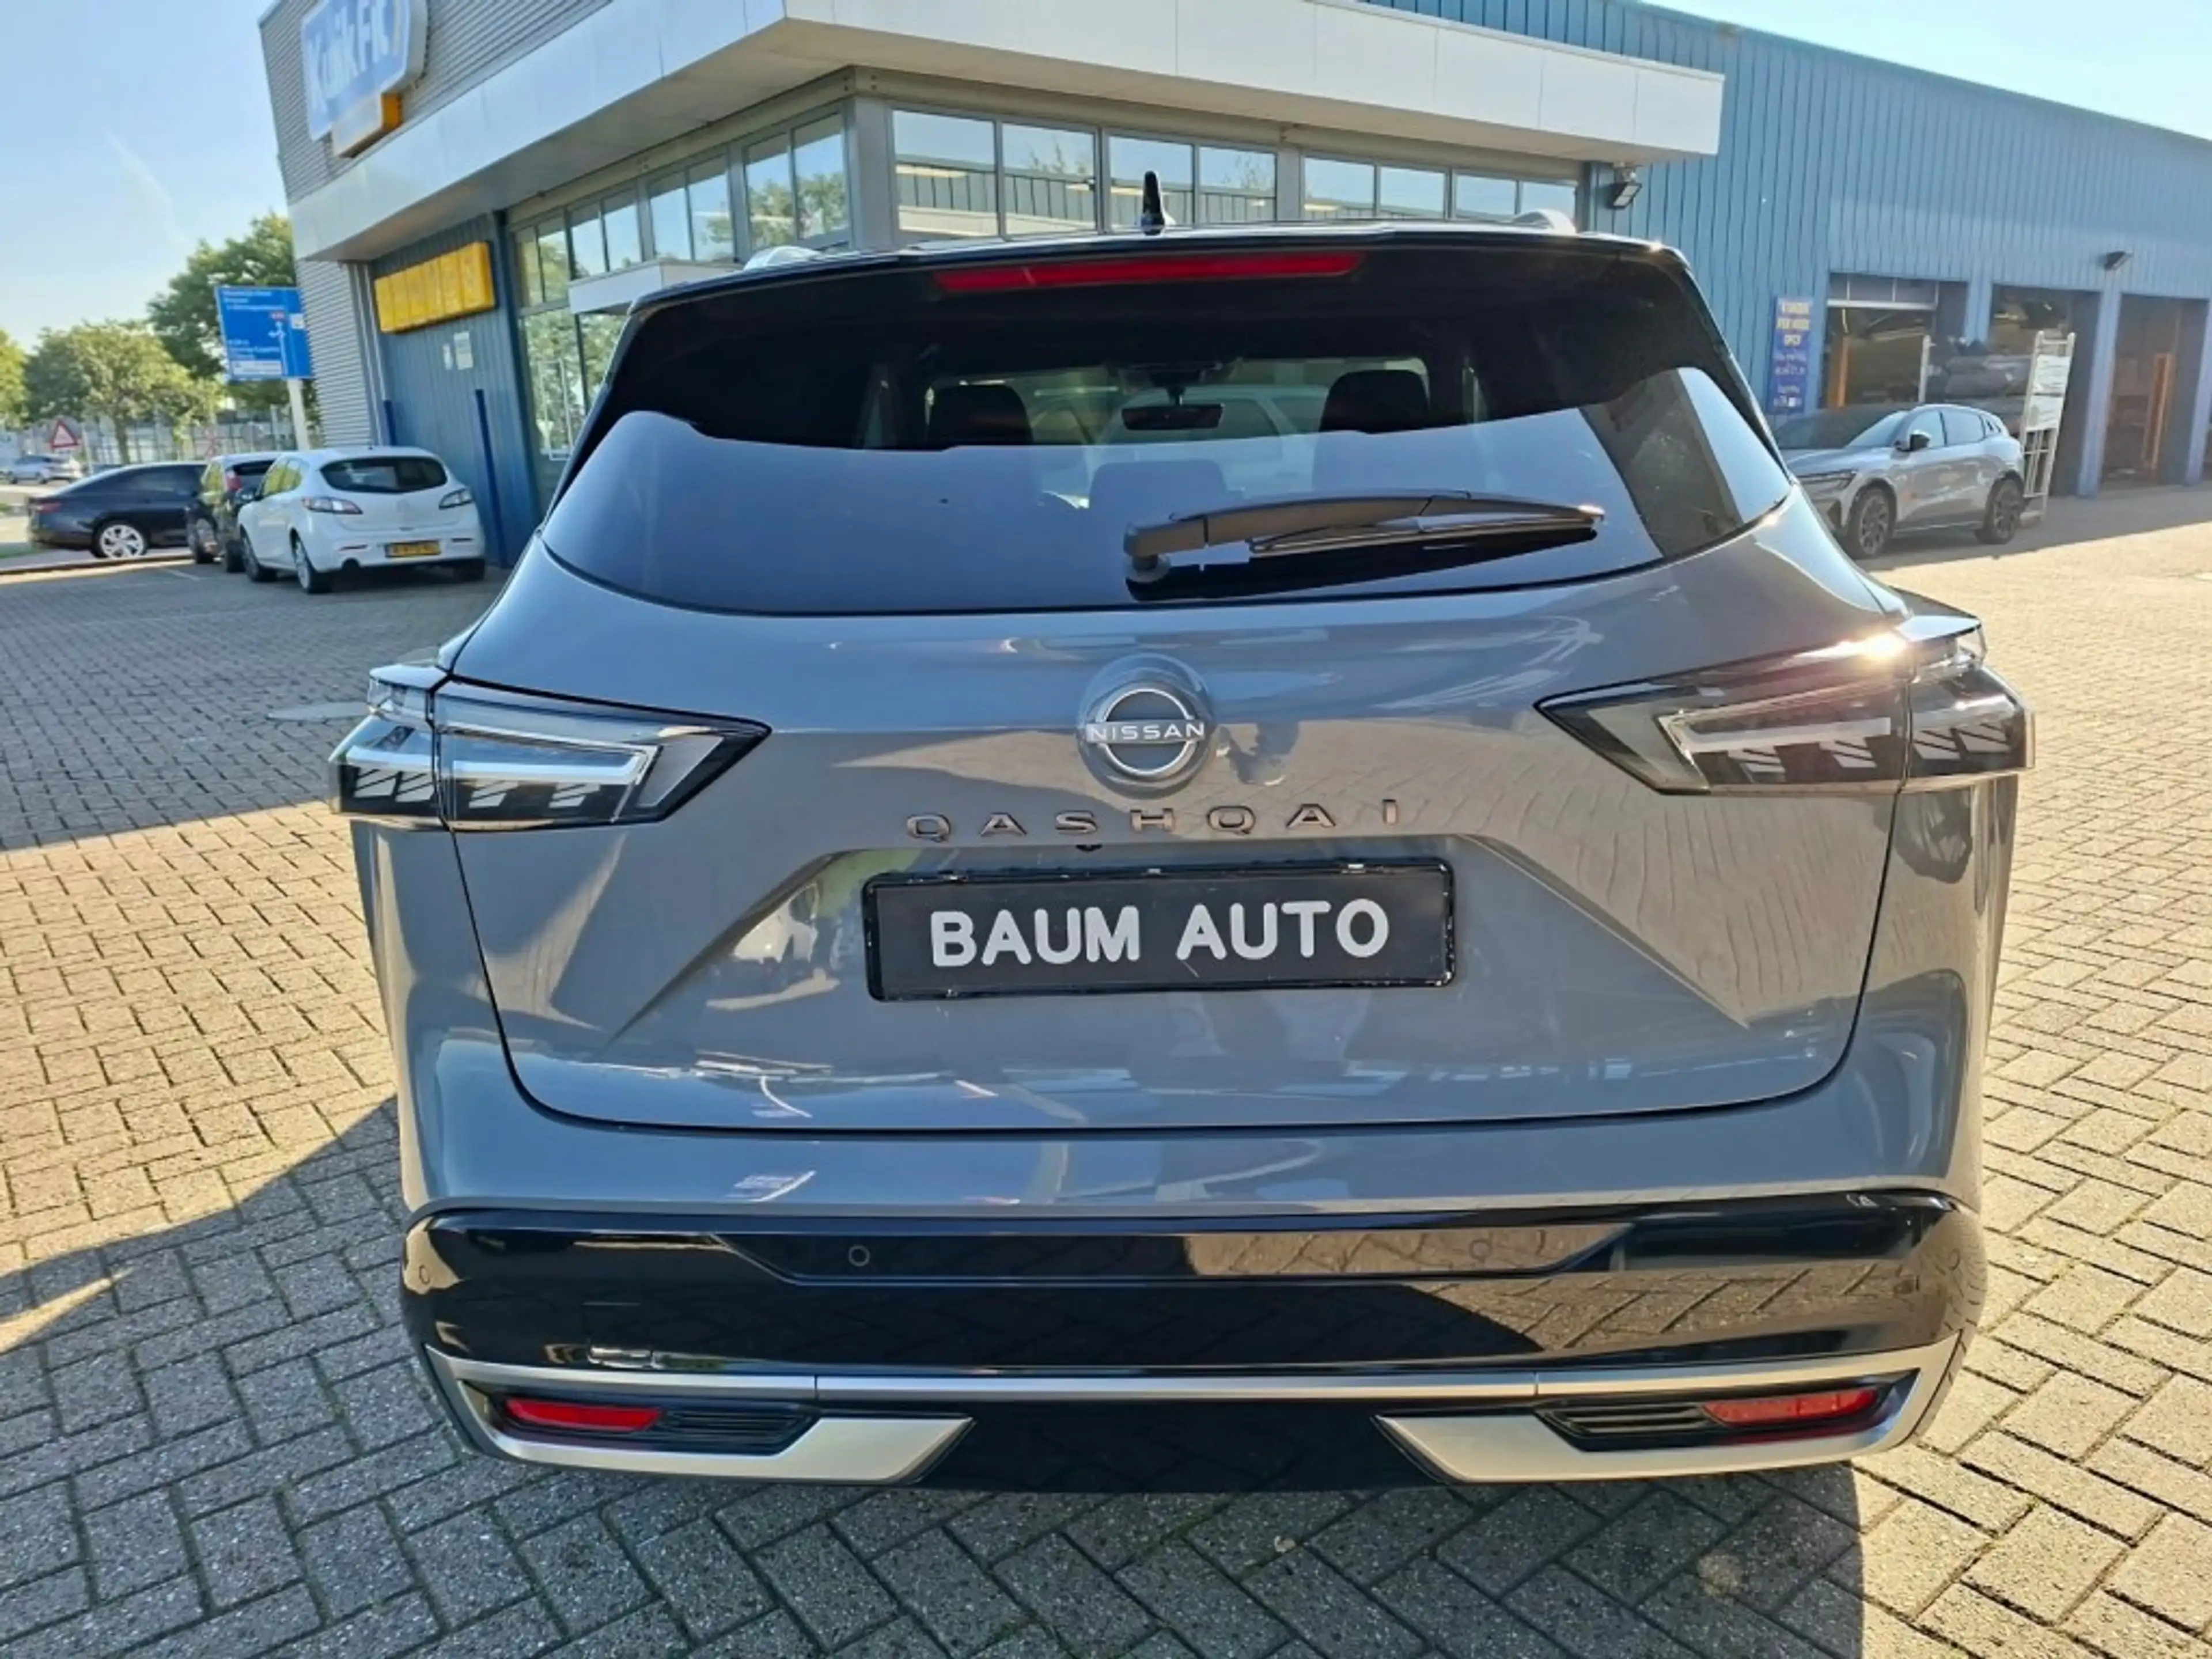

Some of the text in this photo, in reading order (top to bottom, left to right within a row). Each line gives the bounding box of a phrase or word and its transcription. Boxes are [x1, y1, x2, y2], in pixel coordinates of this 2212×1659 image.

[1090, 722, 1205, 740] NISSAN
[906, 798, 1399, 842] QASHQAI
[930, 897, 1390, 968] BAUM AUTO
